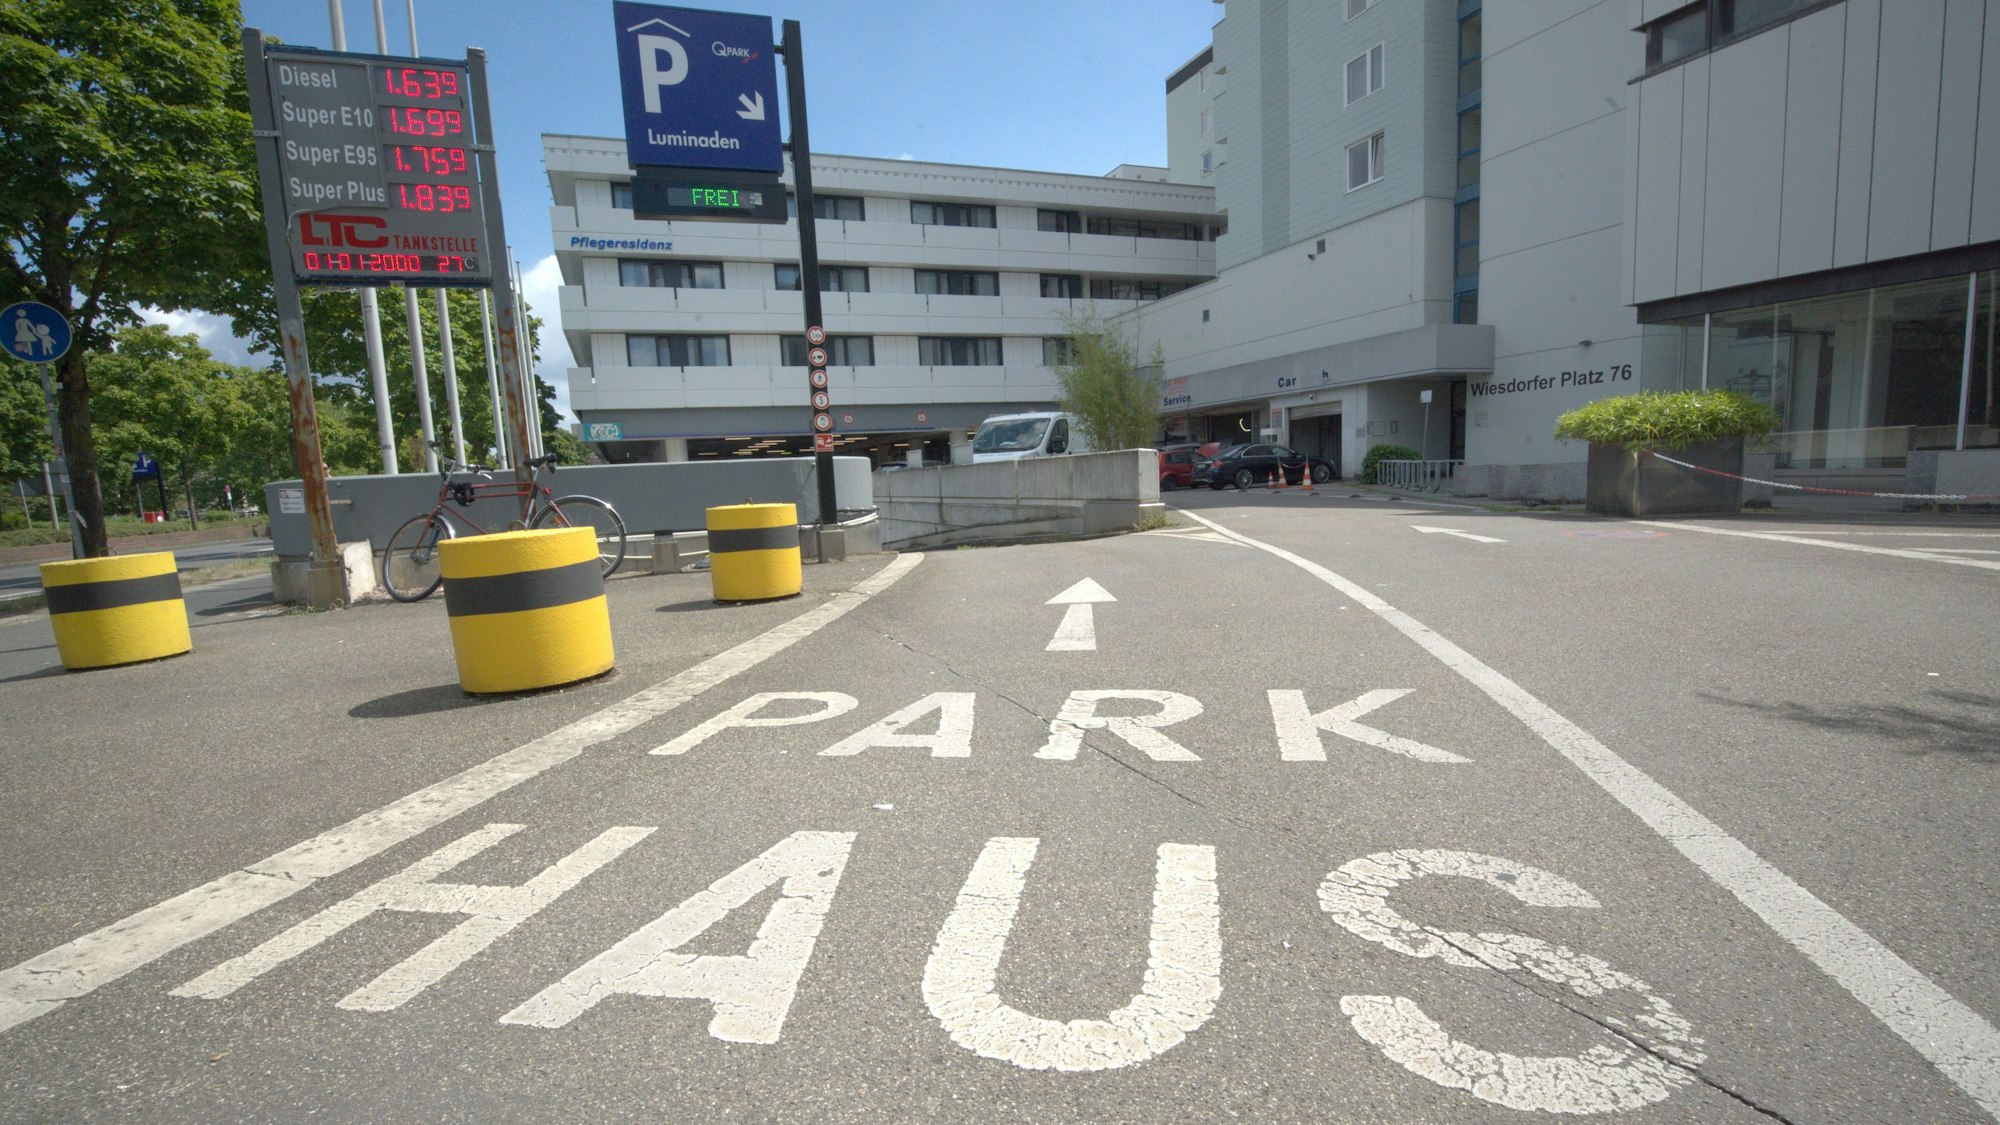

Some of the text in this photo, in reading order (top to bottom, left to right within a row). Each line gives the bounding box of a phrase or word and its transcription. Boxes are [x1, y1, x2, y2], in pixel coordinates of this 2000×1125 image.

[279, 64, 458, 99] Diesel 1.639
[637, 34, 689, 114] P
[282, 101, 463, 137] Super E10 1.699
[648, 128, 740, 150] Luminaden
[286, 140, 467, 176] Super E95 1.759
[289, 176, 472, 213] Super Plus 1.839
[692, 188, 740, 207] FREI
[393, 235, 478, 253] TANKSTELLE
[570, 237, 673, 250] Pflegeresidenz
[1278, 377, 1297, 388] Car
[1471, 364, 1633, 397] Wiesdorfer Platz 76
[819, 396, 824, 405] 5
[1163, 395, 1191, 406] Service
[648, 688, 1475, 764] PARK
[167, 822, 1707, 1116] HAUS
